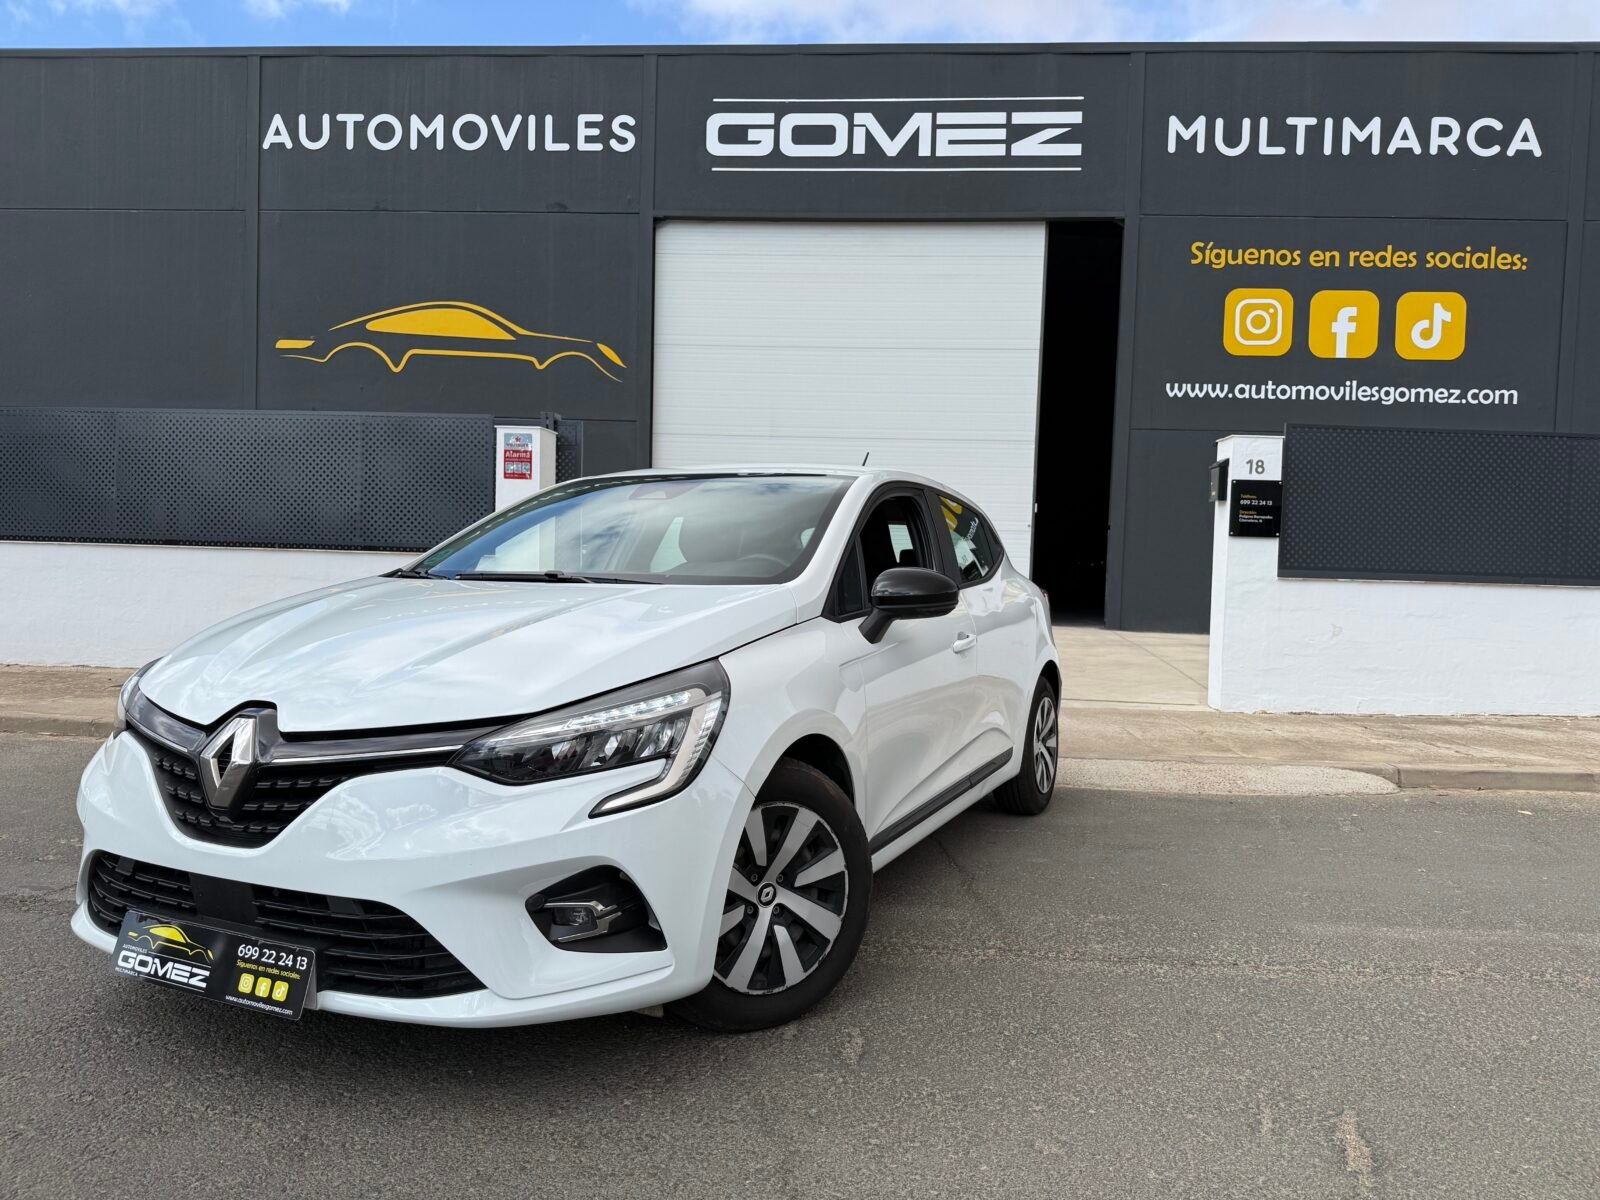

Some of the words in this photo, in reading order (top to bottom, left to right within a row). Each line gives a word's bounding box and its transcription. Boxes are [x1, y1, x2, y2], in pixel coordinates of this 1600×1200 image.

[262, 113, 636, 153] AUTOMOVILES
[706, 111, 1083, 158] GOMEZ
[1167, 115, 1542, 158] MULTIMARCA
[1190, 241, 1302, 269] Síguenos
[1309, 248, 1340, 267] en
[1348, 245, 1418, 268] redes
[1425, 246, 1529, 270] sociales:
[1165, 380, 1519, 406] www.automovilesgomez.com
[1246, 459, 1265, 475] 18
[122, 944, 148, 953] AUTOMOVILES
[237, 944, 259, 960] 699
[261, 949, 276, 964] 22
[278, 952, 293, 968] 24
[296, 956, 308, 970] 13
[117, 950, 210, 988] GOMEZ
[225, 995, 293, 1015] www.automovilesgomez.com
